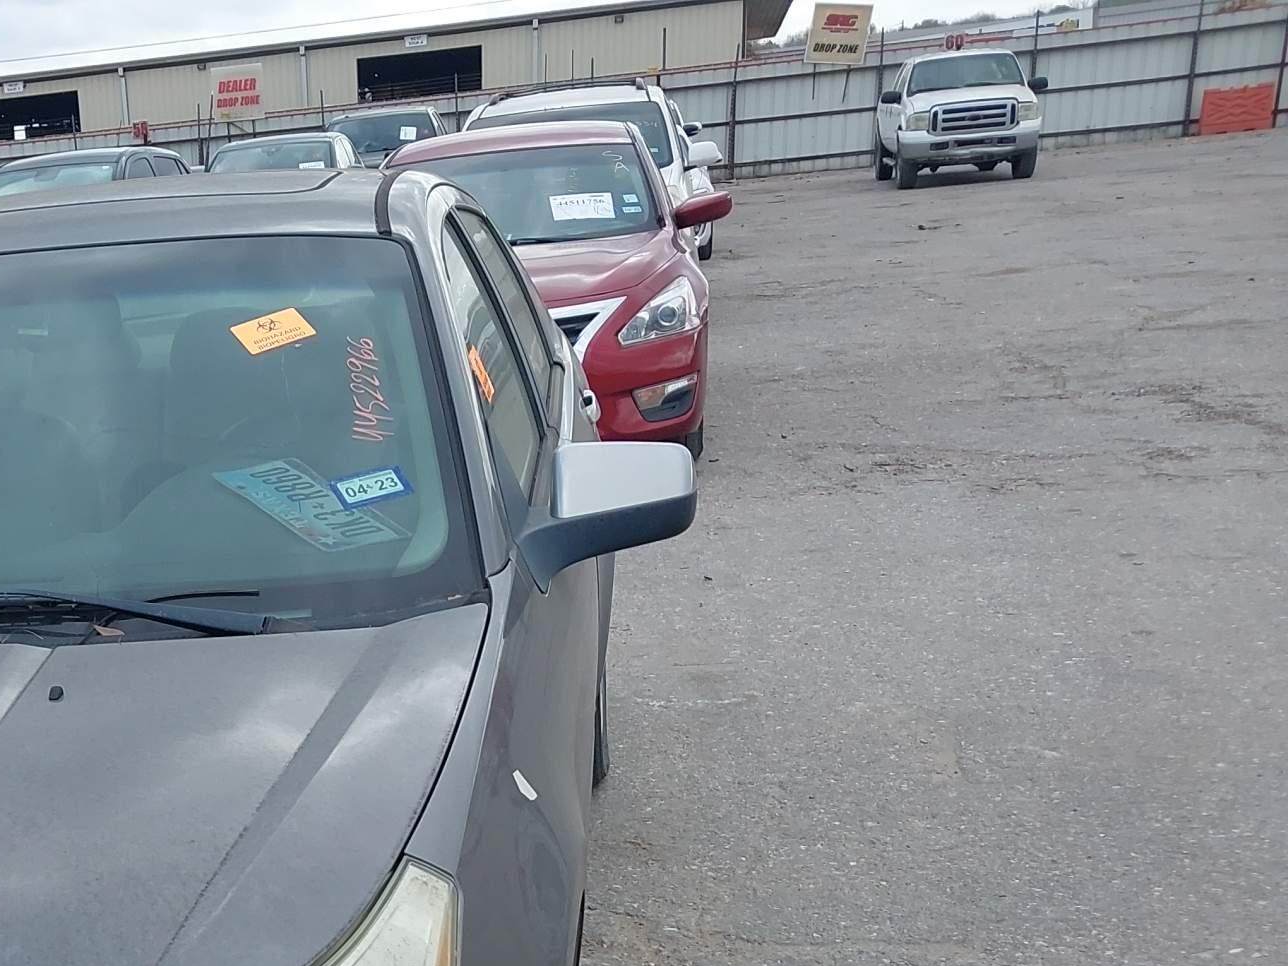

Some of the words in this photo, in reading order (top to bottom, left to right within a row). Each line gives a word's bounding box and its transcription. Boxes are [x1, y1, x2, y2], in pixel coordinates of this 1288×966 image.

[813, 42, 837, 53] DROP
[837, 44, 859, 54] ZONE
[945, 34, 964, 50] 60
[218, 78, 257, 94] DEALER
[217, 96, 239, 108] DROP
[240, 95, 261, 106] ZONE
[254, 326, 301, 345] BIOHAZARD
[346, 336, 395, 441] 44522966
[344, 484, 369, 498] 04
[374, 476, 399, 491] 23
